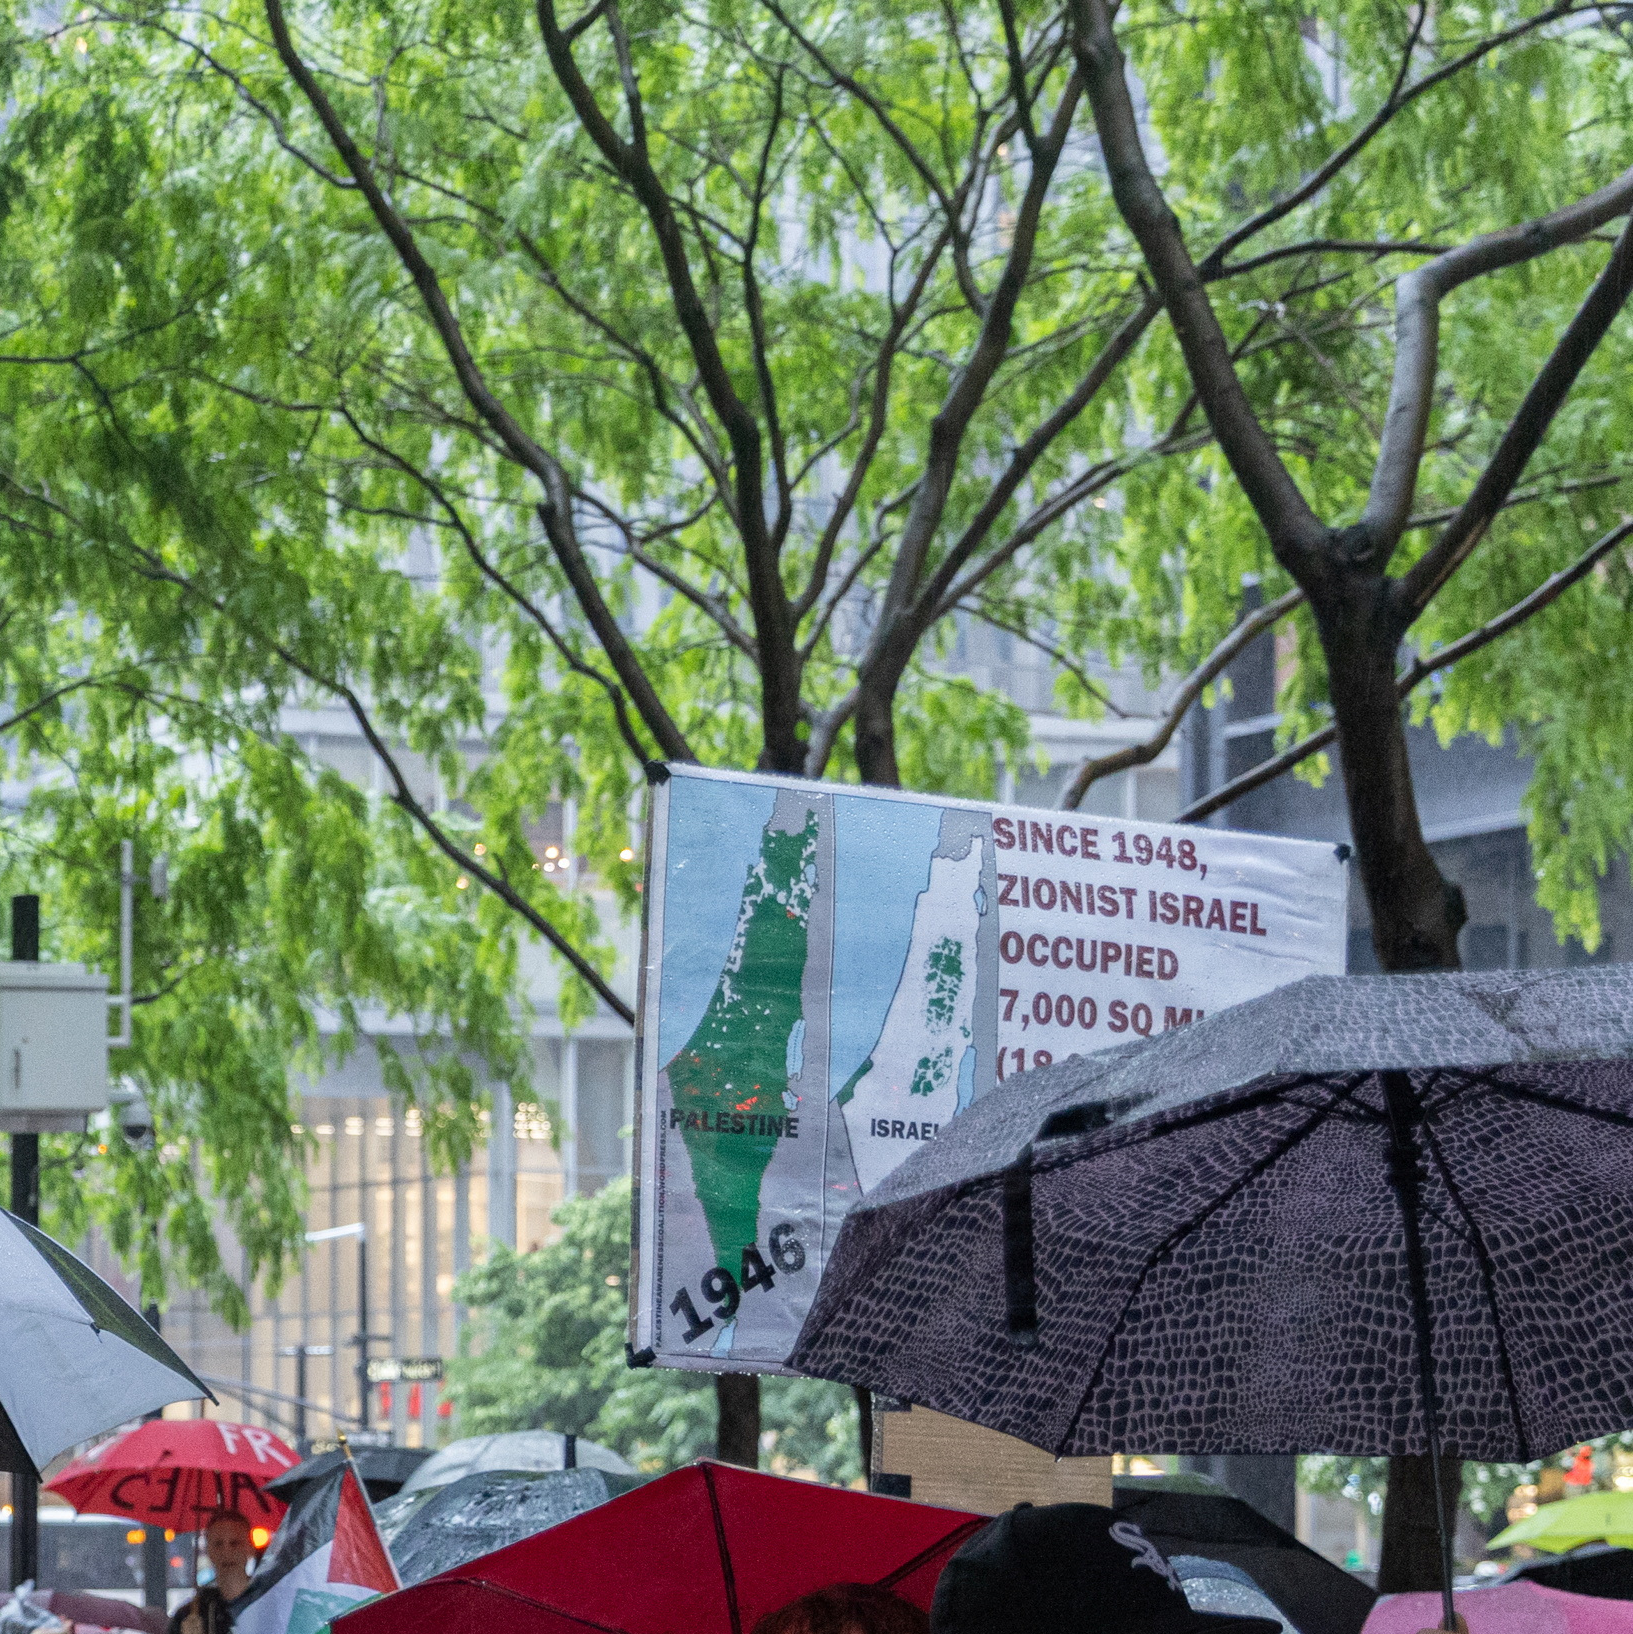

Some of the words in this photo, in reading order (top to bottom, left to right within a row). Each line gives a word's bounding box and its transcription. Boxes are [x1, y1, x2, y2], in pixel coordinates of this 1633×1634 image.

[992, 816, 1101, 861] SINCE
[1111, 830, 1208, 881] 1948,
[996, 873, 1138, 920] ZIONIST
[1148, 890, 1267, 937] ISRAEL
[998, 930, 1179, 981] OCCUPIED
[998, 988, 1098, 1032] 7,000
[1106, 999, 1154, 1038] SQ
[669, 1108, 799, 1139] PALESTINE
[668, 1222, 807, 1345] 1946
